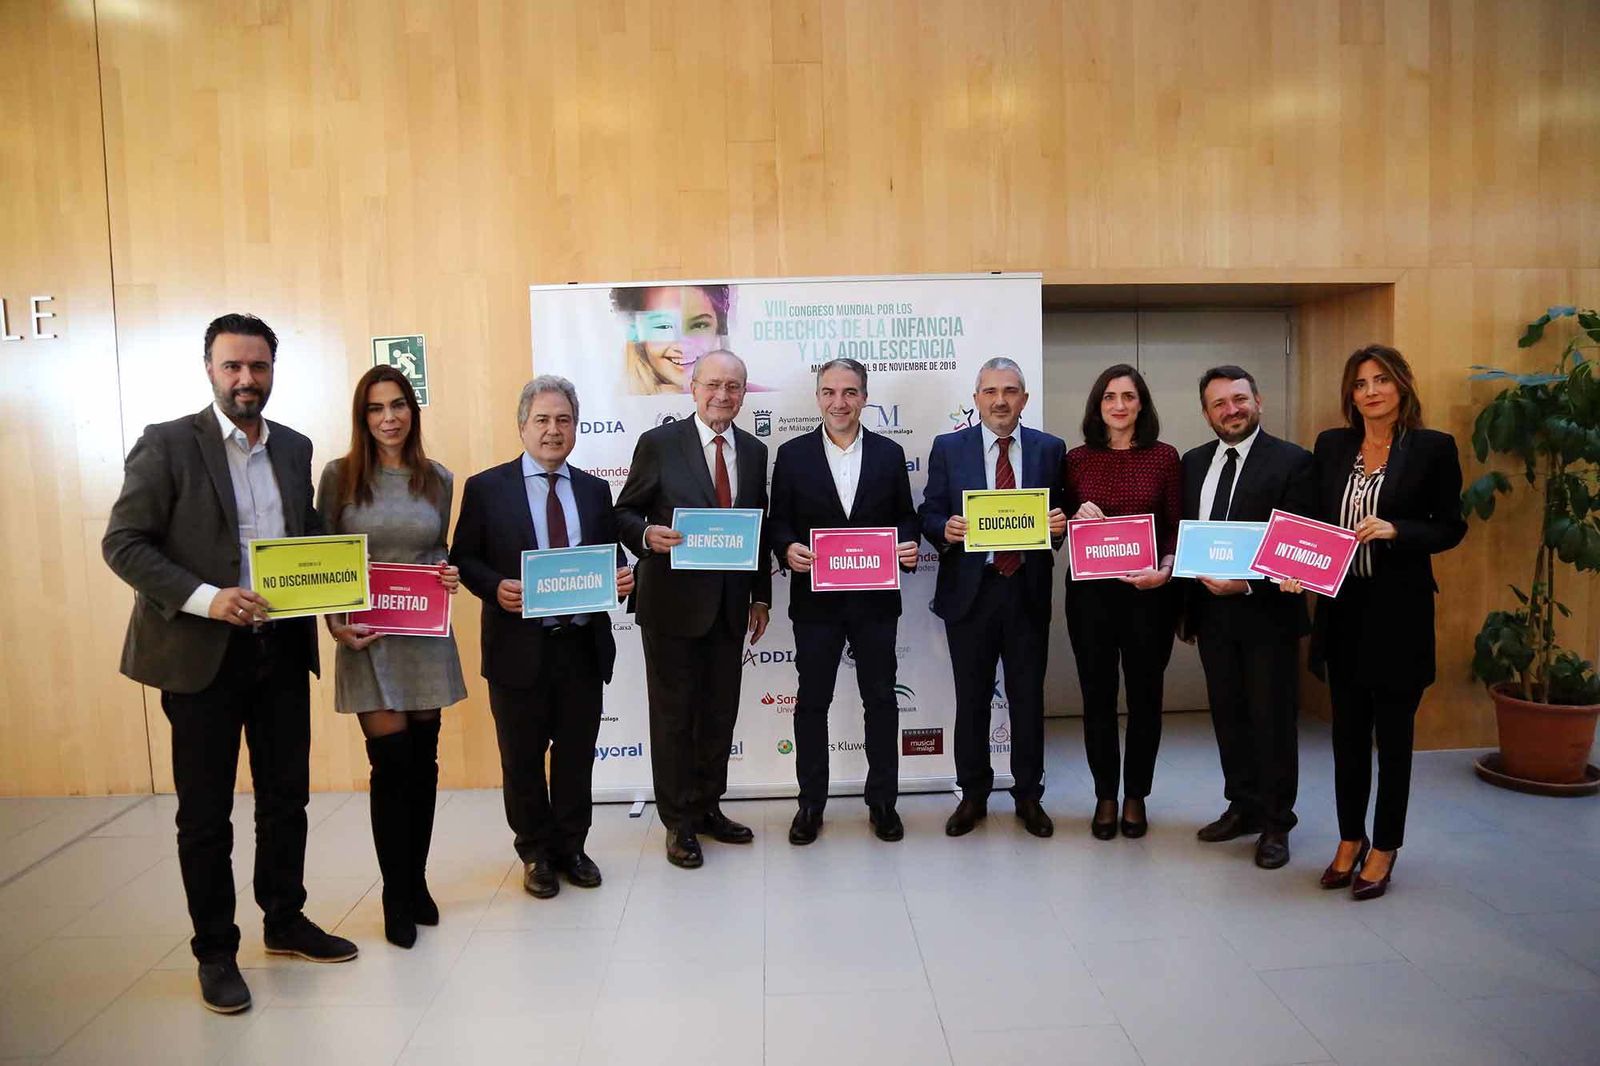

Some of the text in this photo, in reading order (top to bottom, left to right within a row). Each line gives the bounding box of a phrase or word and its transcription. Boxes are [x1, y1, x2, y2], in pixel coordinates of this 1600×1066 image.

[765, 300, 912, 317] VIII CONGRESO MUNDIAL POR LOS
[754, 316, 964, 341] DERECHOS DE LA INFANCIA
[798, 338, 955, 362] Y LA ADOLESCENCIA
[873, 363, 877, 371] 9
[879, 363, 887, 371] DE
[889, 362, 927, 371] NOVIEMBRE
[929, 361, 938, 370] DE
[940, 361, 956, 370] 2018
[978, 513, 1035, 531] EDUCACIÓN
[687, 533, 743, 549] BIENESTAR
[1085, 542, 1140, 559] PRIORIDAD
[1209, 546, 1234, 561] VIDA
[1274, 541, 1332, 570] INTIMIDAD
[829, 555, 881, 570] IGUALDAD
[263, 568, 358, 589] NO DISCRIMINACIÓN
[536, 571, 603, 593] ASOCIACIÓN
[371, 593, 429, 611] LIBERTAD
